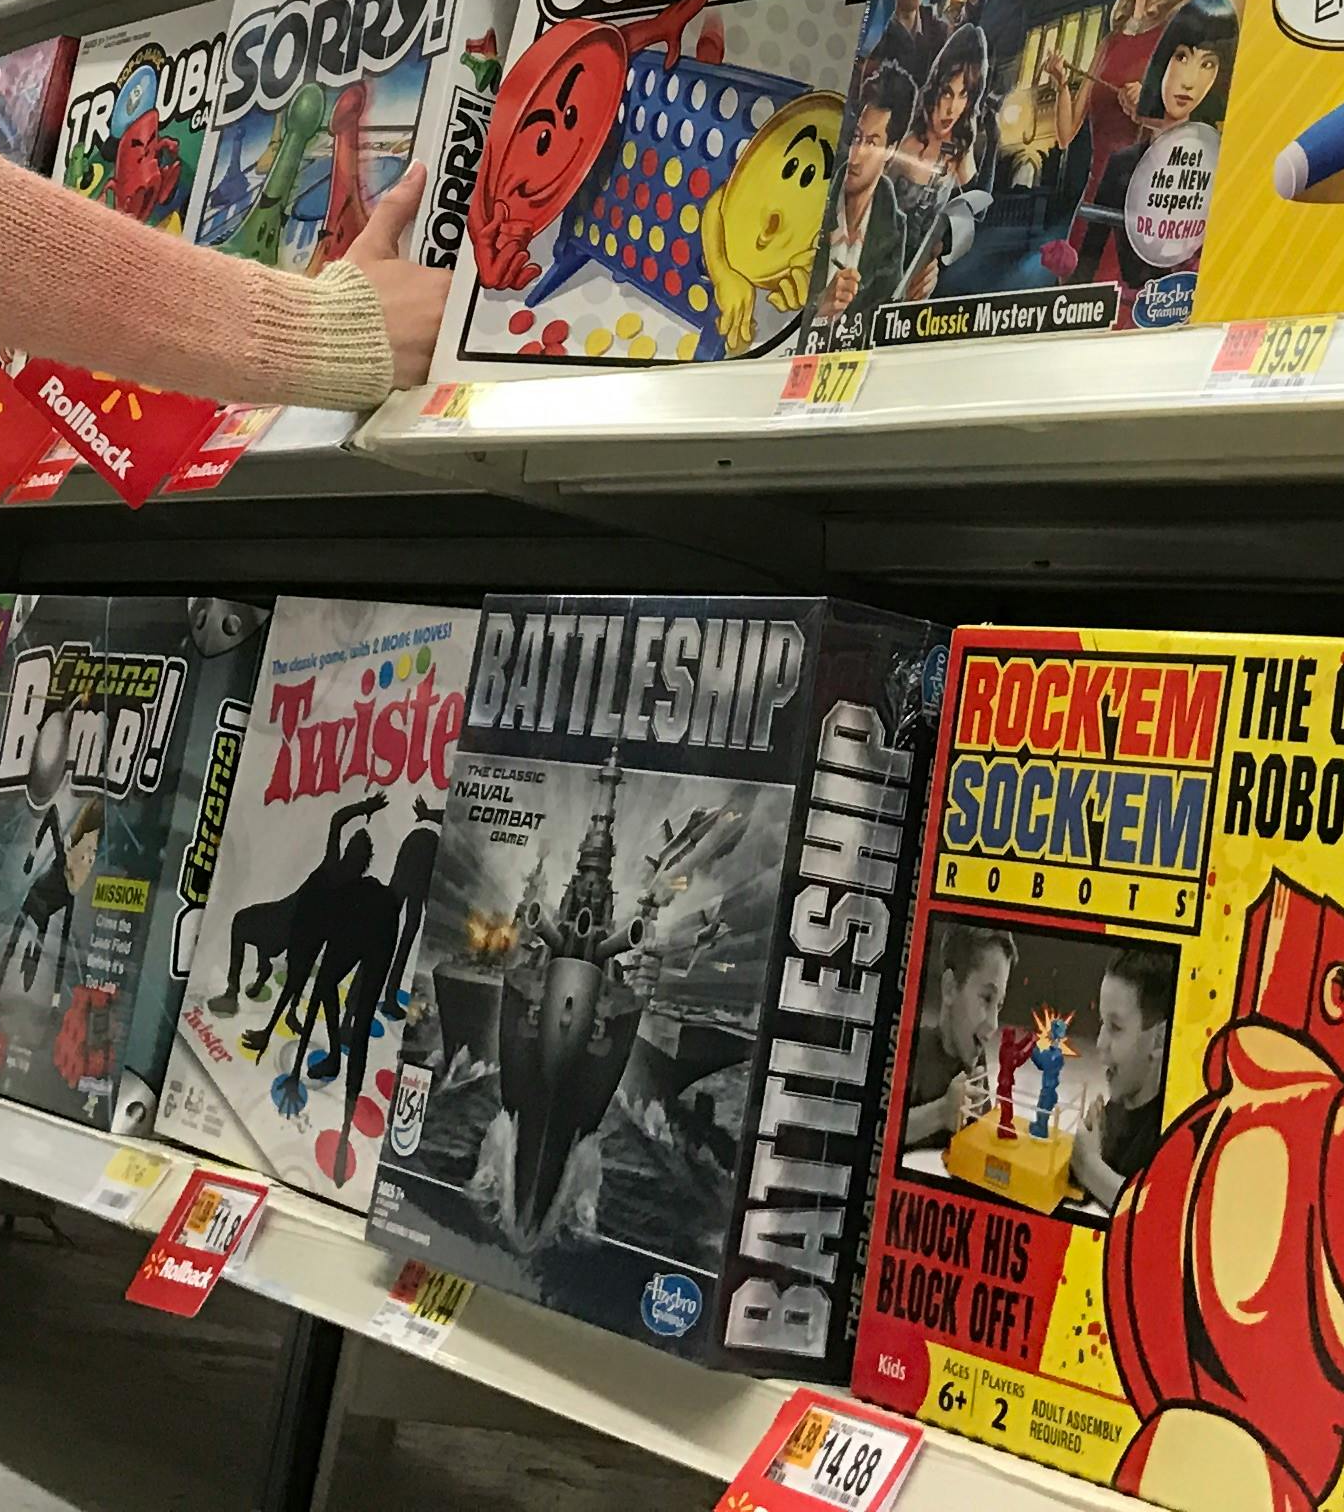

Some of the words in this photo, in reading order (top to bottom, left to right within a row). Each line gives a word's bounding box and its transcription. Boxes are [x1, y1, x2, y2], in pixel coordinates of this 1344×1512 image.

[1167, 146, 1203, 167] Meet
[427, 96, 494, 271] SORRY!
[1151, 169, 1174, 189] the
[1178, 169, 1211, 191] NEW
[1147, 192, 1204, 214] suspect:
[1137, 216, 1155, 237] DR.
[1158, 219, 1206, 240] ORCHID
[1138, 279, 1194, 307] Hasbr
[1147, 304, 1191, 319] Gaming
[885, 310, 912, 339] The
[916, 300, 969, 336] Classic
[972, 299, 1046, 340] Mystery
[1052, 294, 1105, 327] Game
[806, 331, 825, 354] 8+
[38, 376, 135, 480] Rollback
[272, 659, 287, 675] The
[289, 655, 317, 672] classic
[319, 649, 347, 670] game,
[349, 643, 370, 661] with
[381, 633, 411, 652] MORE
[414, 622, 452, 645] MOVES!
[466, 614, 805, 752] BATTLESHIP
[1236, 658, 1313, 744] THE
[956, 656, 1227, 766] ROCK'EM
[264, 662, 466, 806] Twiste
[455, 781, 514, 803] NAVAL
[468, 765, 491, 777] THE
[492, 768, 546, 784] CLASSIC
[468, 805, 546, 830] COMBAT
[944, 755, 1212, 877] SOCK'EM
[490, 830, 528, 847] GAME!
[96, 885, 146, 907] MISSION:
[182, 1005, 233, 1065] Twister
[723, 700, 916, 1357] BATTLESHIP
[397, 1087, 425, 1125] USA
[885, 1191, 974, 1266] KNOCK
[982, 1214, 1035, 1284] HIS
[159, 1257, 214, 1289] Rollback
[646, 1275, 697, 1315] Hasbro
[876, 1255, 969, 1329] BLOCK
[969, 1281, 1035, 1358] OFF!
[878, 1353, 906, 1381] Kids
[943, 1357, 970, 1381] AGES
[981, 1369, 1025, 1399] PLAYERS
[938, 1381, 968, 1412] 6+
[991, 1397, 1009, 1432] 2
[1031, 1398, 1065, 1425] ADULT
[1066, 1408, 1123, 1444] ASSEMBLY
[1029, 1422, 1085, 1456] REQUIRED.
